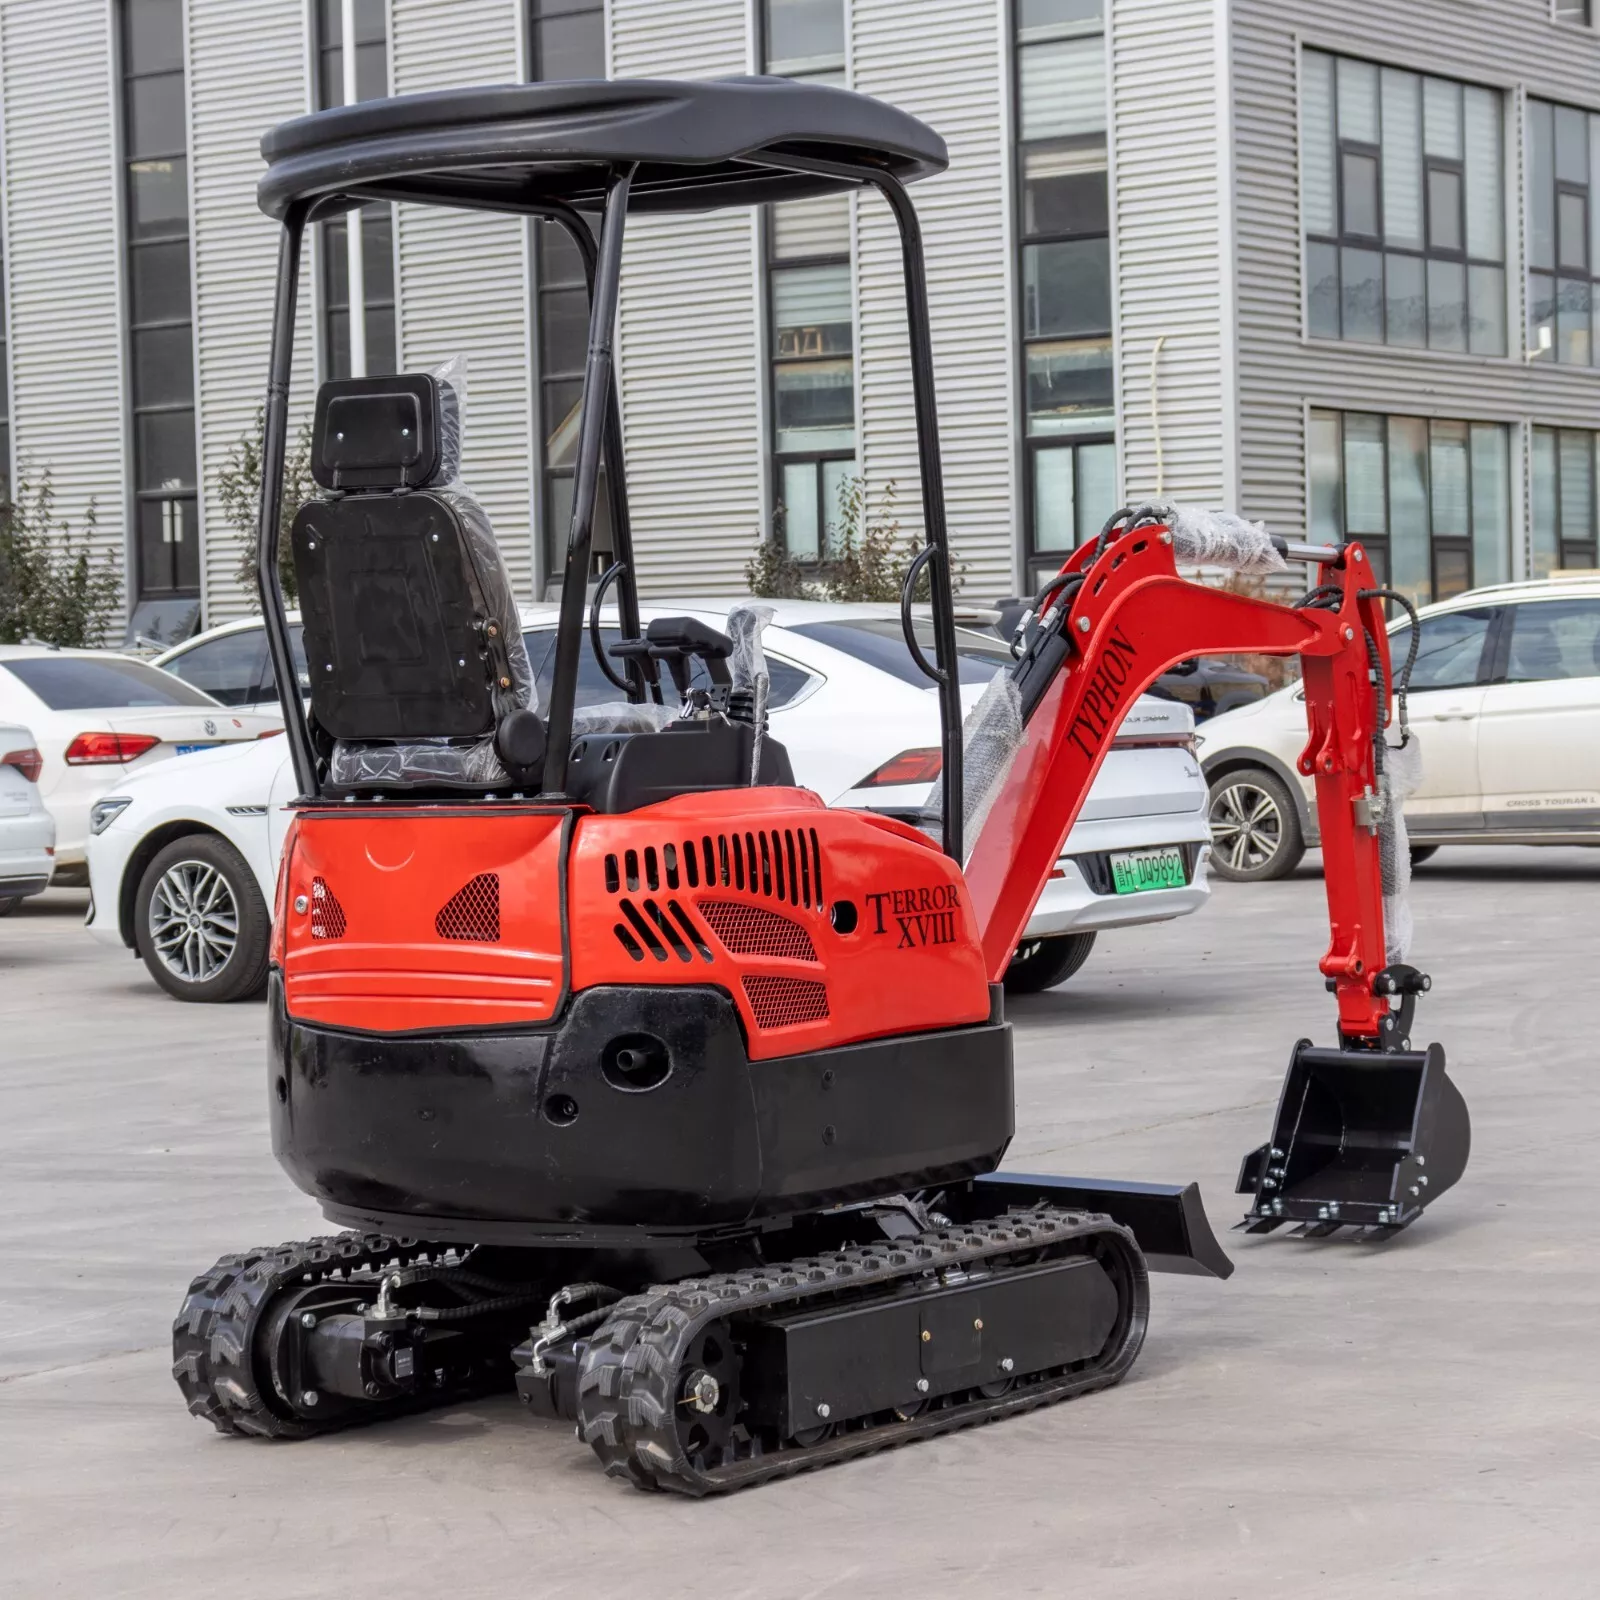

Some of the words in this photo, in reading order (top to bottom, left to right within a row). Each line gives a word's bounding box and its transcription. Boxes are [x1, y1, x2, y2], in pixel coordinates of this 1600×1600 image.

[1066, 624, 1138, 762] TYPHON
[865, 884, 961, 934] TERROR
[896, 911, 956, 949] XVIII
